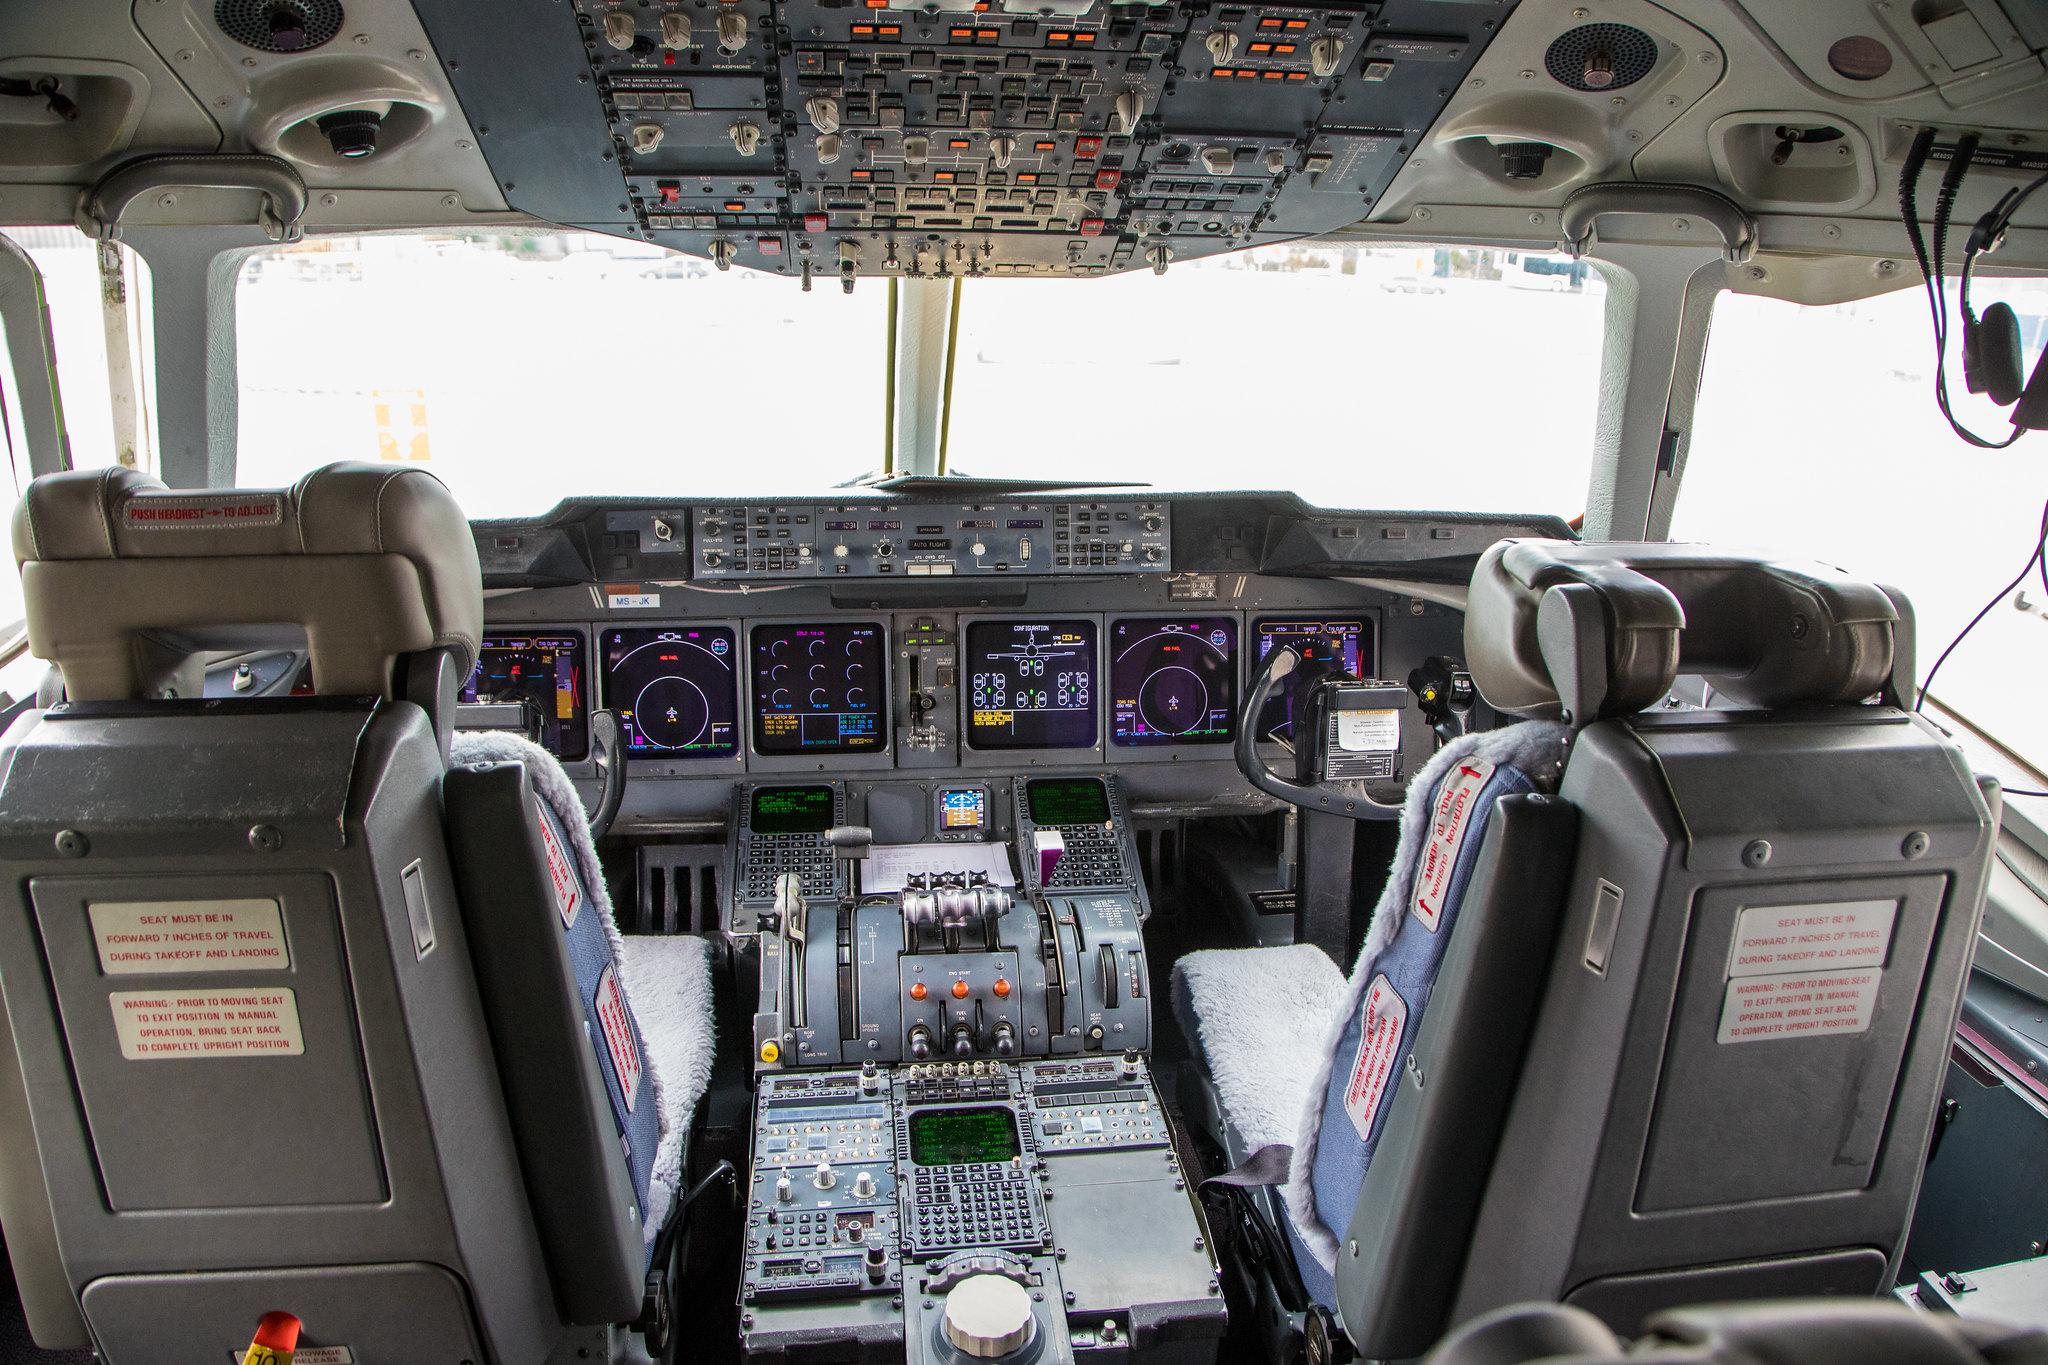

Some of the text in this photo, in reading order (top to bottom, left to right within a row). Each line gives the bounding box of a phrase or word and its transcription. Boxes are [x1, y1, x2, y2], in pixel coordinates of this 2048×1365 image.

[1971, 156, 2006, 165] MICROPHONE
[131, 505, 275, 519] PUSH HEADREST TO ADJUST
[1425, 790, 1454, 881] PULL TO REMOVE
[1431, 787, 1470, 899] FLOTATION CUSHION
[551, 844, 557, 859] TO
[140, 914, 233, 925] SEAT MUST BE IN
[1778, 919, 1801, 927] SEAT
[1805, 916, 1830, 925] MUST
[1832, 915, 1844, 923] BE
[107, 930, 274, 943] FORWARD 7 INCHES OF TRAVEL
[1743, 930, 1880, 948] FORWARD 7 INCHES OF TRAVEL
[110, 948, 279, 961] DURING TAKEOFF AND LANDING
[1738, 946, 1880, 965] DURING TAKEOFF AND LANDING
[1781, 981, 1805, 990] PRIOR
[1808, 980, 1817, 988] TO
[1819, 977, 1849, 987] MOVING
[1851, 976, 1872, 984] SEAT
[177, 998, 205, 1006] PRIOR
[207, 998, 219, 1006] TO
[221, 997, 258, 1006] MOVING
[261, 996, 283, 1005] SEAT
[1373, 988, 1381, 1002] BE
[1743, 999, 1753, 1008] TO
[1756, 997, 1773, 1006] EXIT
[1775, 994, 1813, 1004] POSITION
[1827, 990, 1859, 1000] MANUAL
[136, 1011, 278, 1022] TO EXIT POSITION IN MANUAL
[1368, 1002, 1377, 1027] MUST
[1788, 1008, 1812, 1017] BRING
[1814, 1006, 1833, 1014] SEAT
[1836, 1004, 1857, 1013] BACK
[198, 1027, 227, 1036] BRING
[230, 1026, 253, 1035] SEAT
[256, 1025, 281, 1034] BACK
[1730, 1018, 1858, 1037] TO COMPLETE UPRIGHT POSITION
[1367, 1026, 1376, 1047] REST
[136, 1040, 290, 1052] TO COMPLETE UPRIGHT POSITION
[1361, 1045, 1370, 1069] BACK
[1361, 1016, 1388, 1100] IN UPRIGHT POSITION
[1364, 1016, 1399, 1122] BEFORE MOVING OUTBOARD
